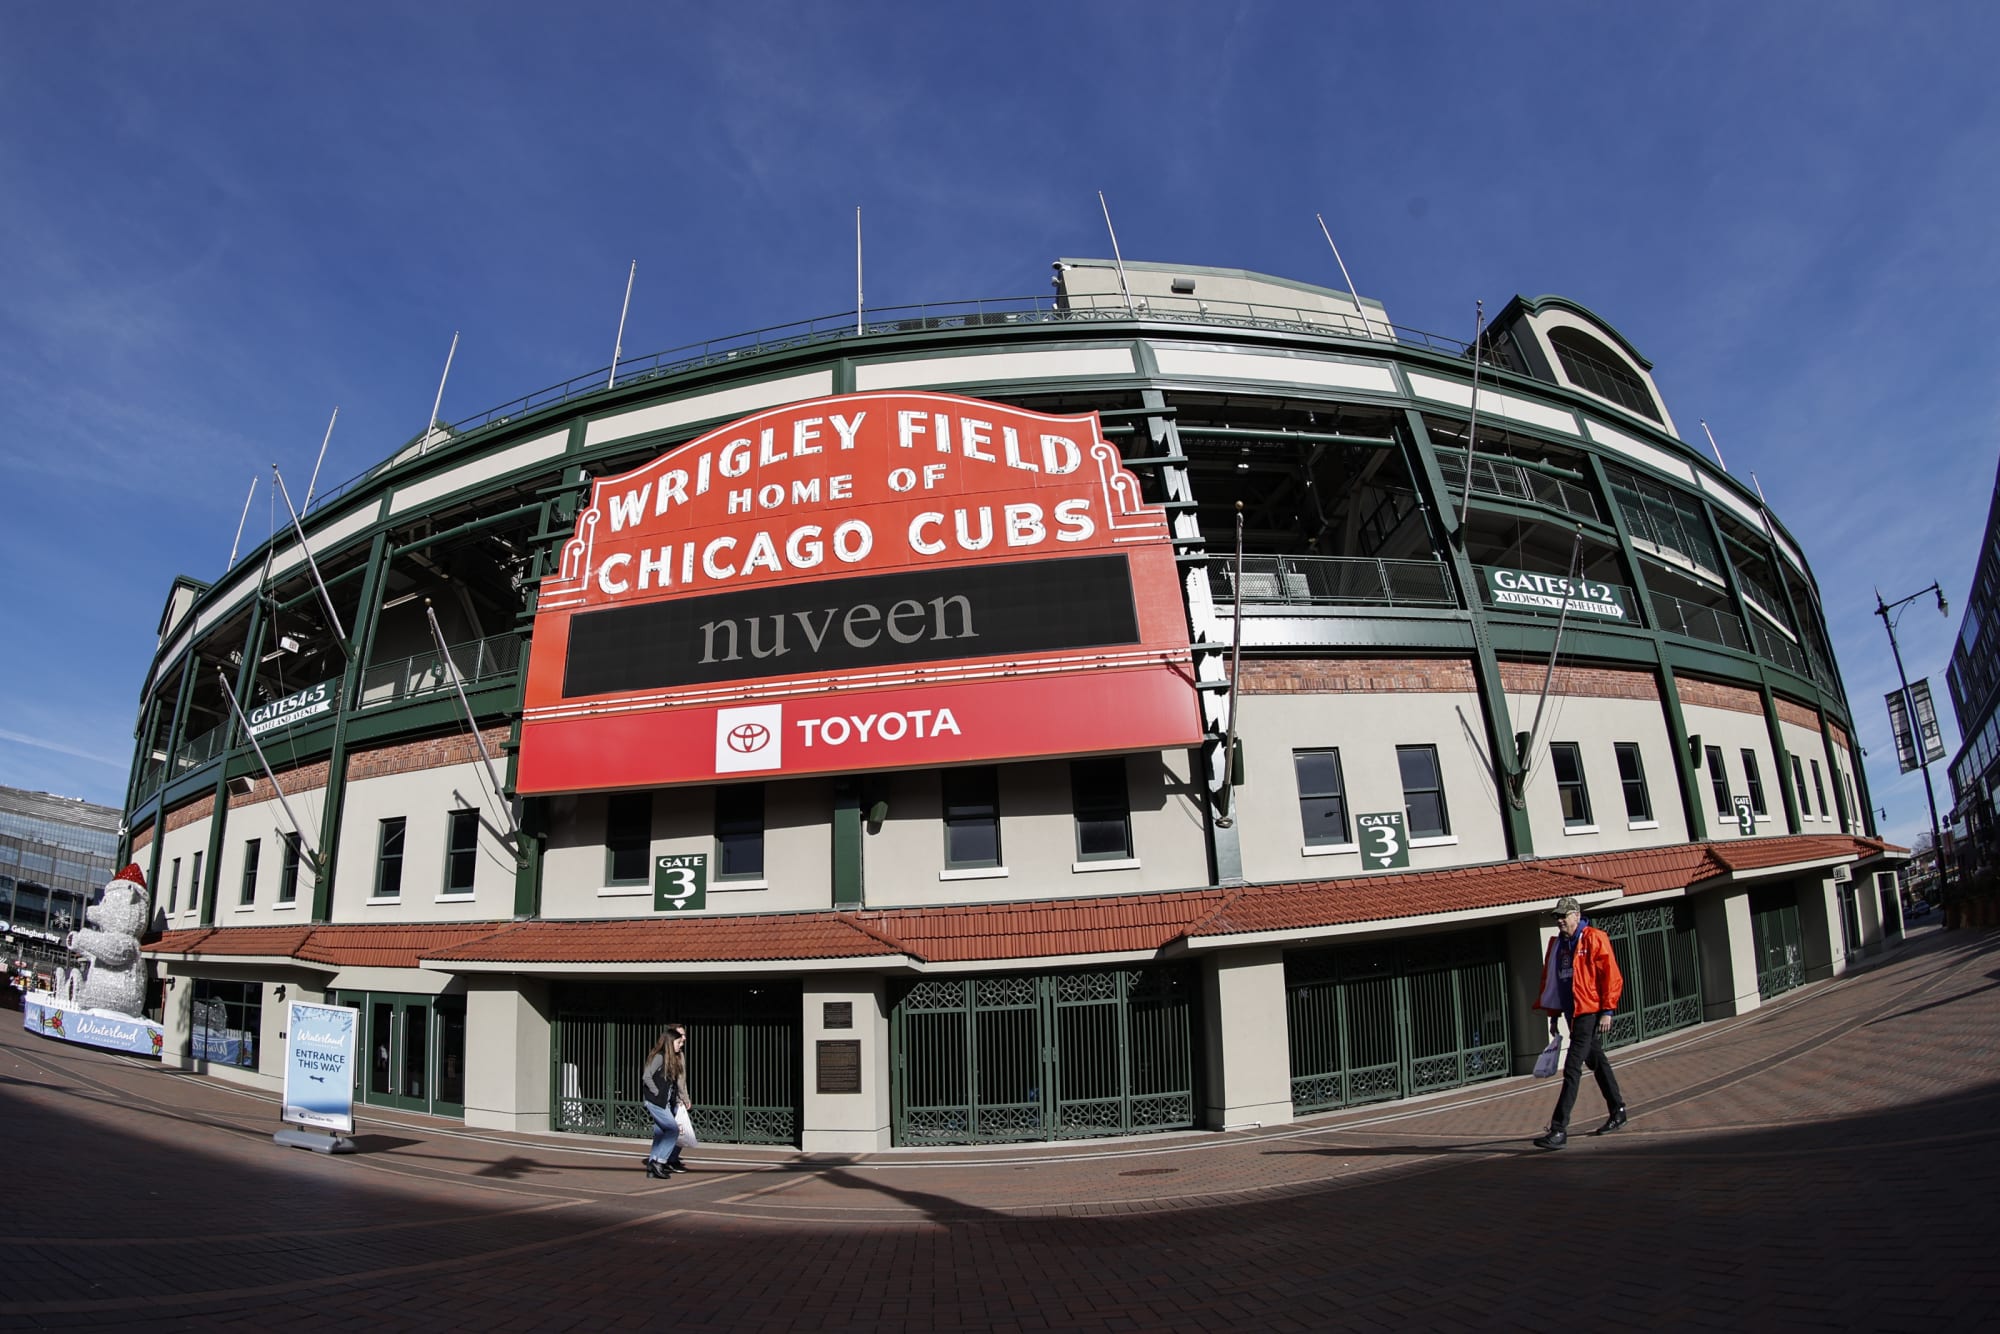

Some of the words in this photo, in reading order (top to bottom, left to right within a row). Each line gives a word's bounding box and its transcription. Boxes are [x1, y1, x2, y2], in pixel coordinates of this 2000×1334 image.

[609, 411, 867, 532] WRIGLEY
[898, 410, 1082, 475] FIELD
[728, 473, 853, 514] HOME
[887, 464, 947, 493] OF
[598, 518, 873, 595] CHICAGO
[908, 499, 1096, 555] CUBS
[1494, 570, 1575, 597] GATES
[1501, 592, 1553, 606] ADDISON
[1568, 600, 1618, 615] SHEFFIELD
[698, 594, 979, 664] nuveen
[252, 696, 299, 723] GATES
[797, 708, 962, 747] TOYOTA
[1734, 797, 1750, 805] GATE
[1360, 814, 1401, 826] GATE
[1739, 805, 1751, 827] 3
[1368, 826, 1399, 857] 3
[659, 856, 703, 867] GATE
[664, 868, 696, 899] 3
[11, 924, 45, 939] Gallagher
[45, 932, 60, 943] Way
[77, 1018, 138, 1043] Winterland
[297, 1029, 345, 1047] Winterland
[296, 1049, 345, 1064] ENTRANCE
[298, 1059, 319, 1070] THIS
[320, 1062, 341, 1072] WAY
